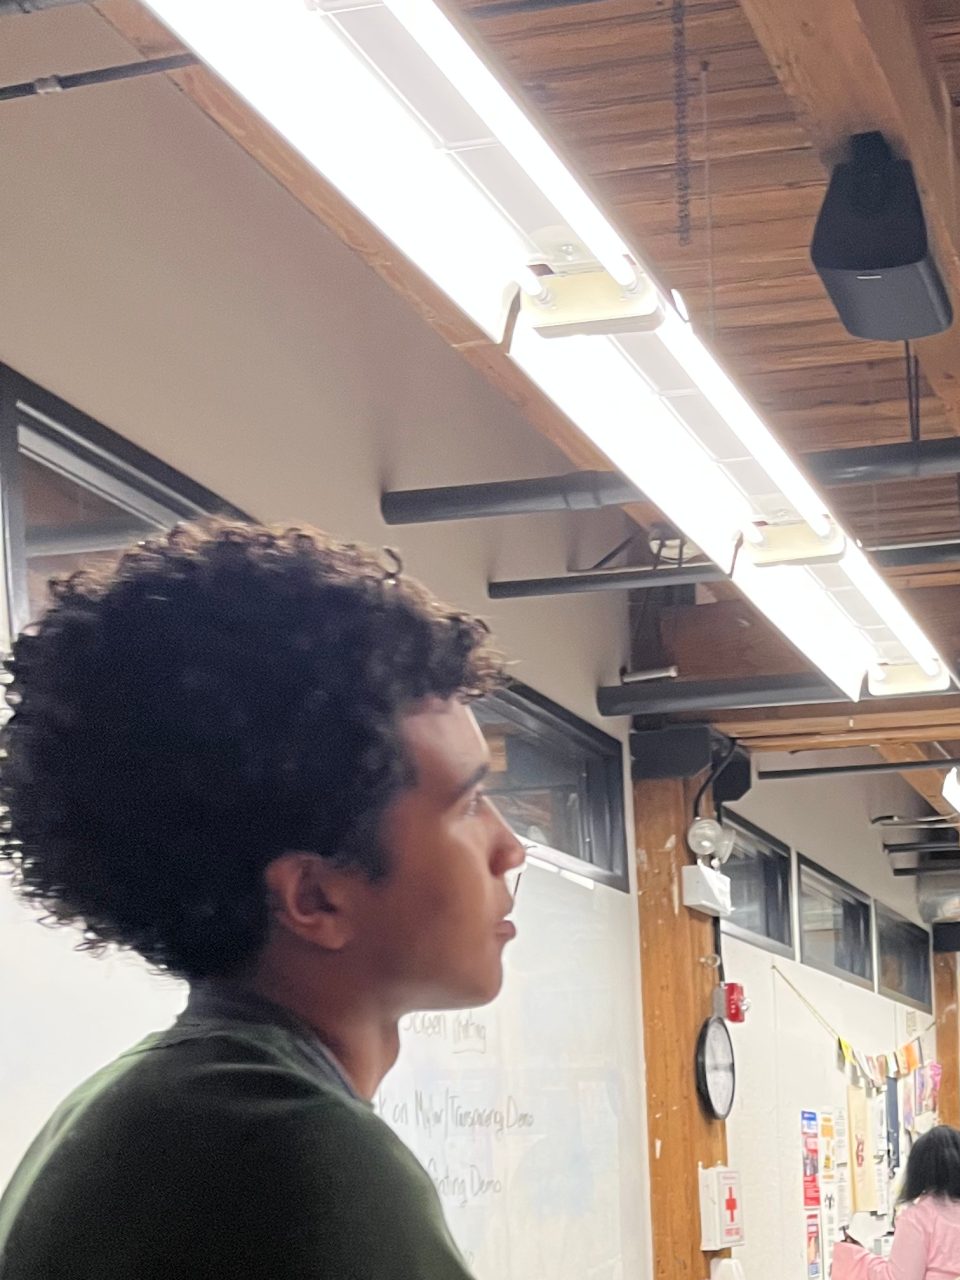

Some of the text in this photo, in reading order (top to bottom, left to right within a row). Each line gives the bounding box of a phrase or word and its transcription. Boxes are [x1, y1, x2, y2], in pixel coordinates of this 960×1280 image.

[392, 1102, 408, 1126] on
[506, 1095, 535, 1128] Demo
[470, 1164, 502, 1196] Demo
